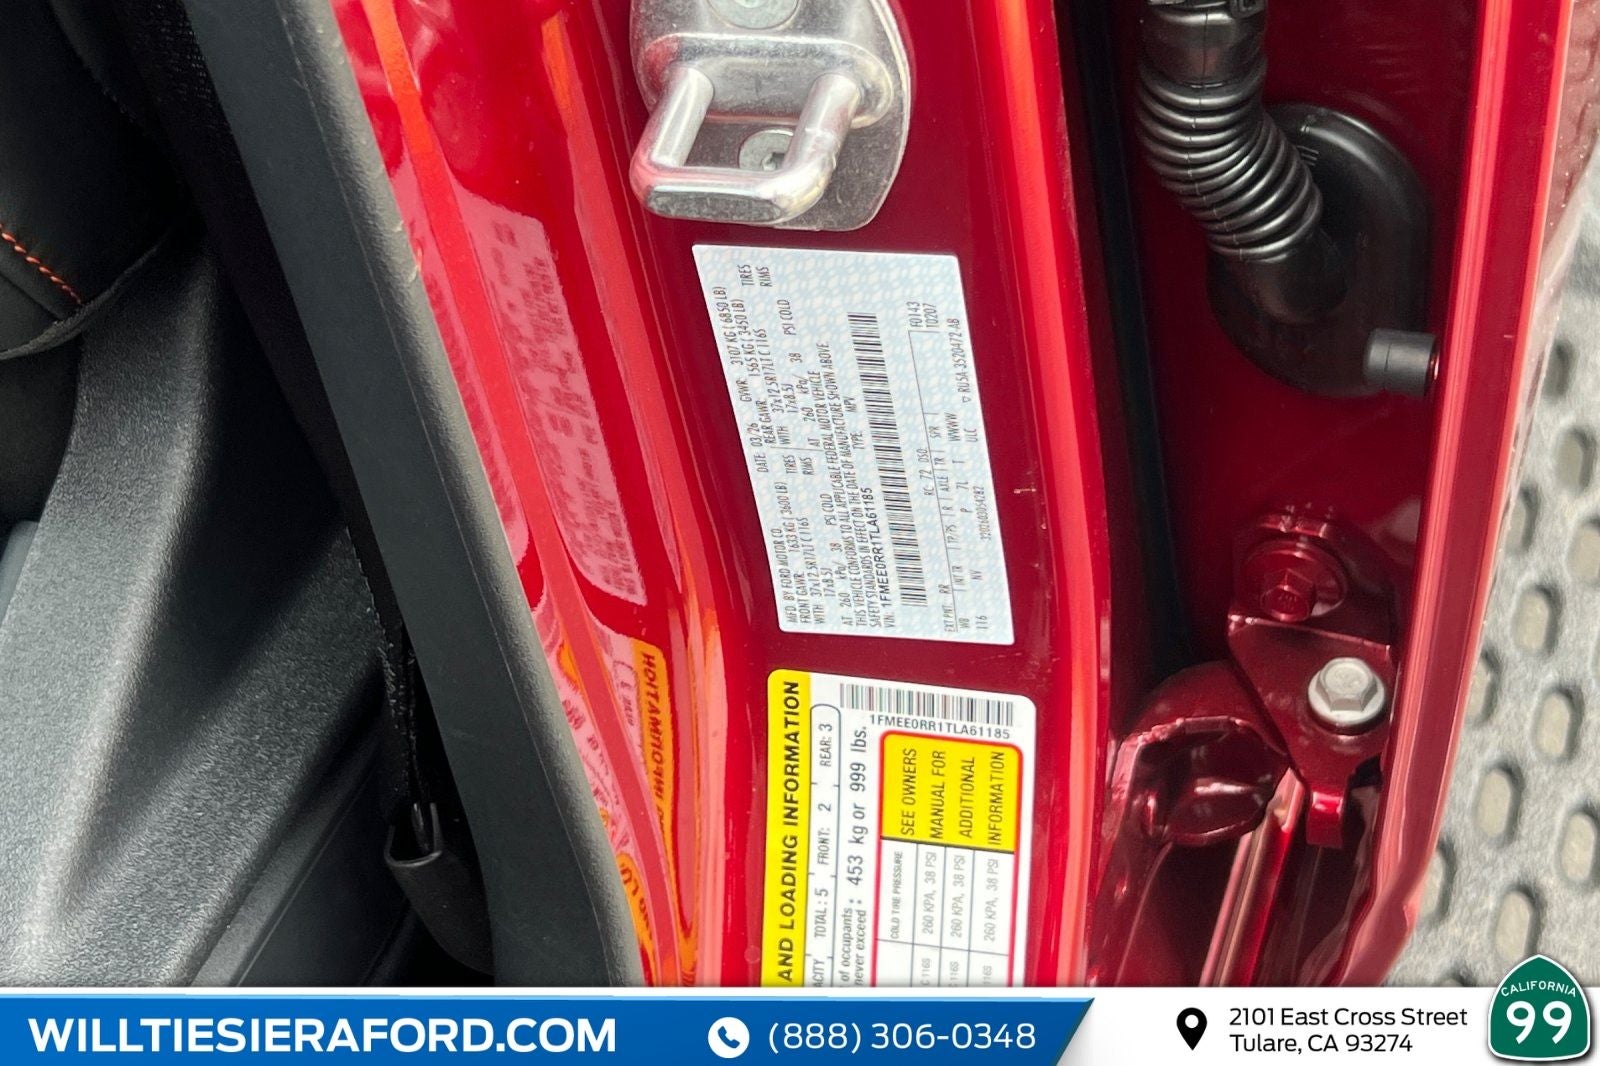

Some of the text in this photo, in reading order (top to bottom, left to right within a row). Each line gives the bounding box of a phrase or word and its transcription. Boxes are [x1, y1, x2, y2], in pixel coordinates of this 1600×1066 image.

[737, 264, 754, 286] TIRES
[755, 266, 772, 286] RIMS
[716, 301, 733, 323] 6850
[776, 299, 793, 320] COLD
[734, 314, 751, 335] 3450
[782, 323, 796, 335] PSI
[723, 330, 737, 342] KG
[726, 345, 742, 365] 3107
[741, 343, 755, 354] KG
[788, 352, 802, 363] 38
[744, 357, 761, 376] 1565
[822, 371, 840, 400] SHOWN
[842, 395, 858, 412] MPV
[800, 406, 815, 421] 260
[760, 424, 776, 443] REAR
[775, 425, 791, 444] WITH
[828, 402, 851, 457] MANUFACTURE
[782, 454, 798, 474] TIRES
[798, 456, 814, 475] RIMS
[840, 459, 854, 469] OF
[842, 471, 858, 489] DATE
[918, 469, 932, 479] 72
[807, 370, 868, 626] THIS VEHICLE CONFORMS TO ALL APPLICABLE FEDERAL MOTOR VEHICLE
[819, 493, 834, 512] COLD
[846, 491, 861, 504] THE
[849, 507, 863, 517] ON
[852, 520, 868, 542] EFFECT
[771, 539, 789, 566] MOTOR
[829, 542, 841, 551] 38
[857, 544, 870, 553] IN
[777, 568, 794, 588] FORD
[858, 555, 879, 598] STANDARDS
[937, 584, 951, 593] RR
[837, 592, 852, 607] 260
[794, 597, 813, 623] FRONT
[865, 600, 882, 627] SAFETY
[818, 723, 832, 766] REAR: 3
[900, 747, 917, 835] SEE OWNERS
[929, 750, 946, 839] MANUAL FOR
[958, 756, 975, 838] ADDITIONAL
[987, 750, 1005, 845] INFORMATION
[846, 725, 868, 885] 453 kg or 999 lbs.
[777, 680, 801, 982] AND LOADING INFORMATION
[817, 802, 830, 864] FRONT: 2
[924, 851, 937, 867] PSI
[953, 854, 965, 870] PSI
[986, 858, 998, 874] PSI
[924, 870, 936, 883] 38
[952, 873, 964, 886] 38
[986, 877, 998, 891] 38
[814, 888, 828, 896] 5
[889, 850, 902, 938] COLD TIRE PRESSURE
[921, 915, 934, 934] 260
[950, 918, 962, 937] 260
[983, 922, 995, 941] 260
[837, 907, 854, 981] of occupants
[854, 909, 866, 985] never exceed
